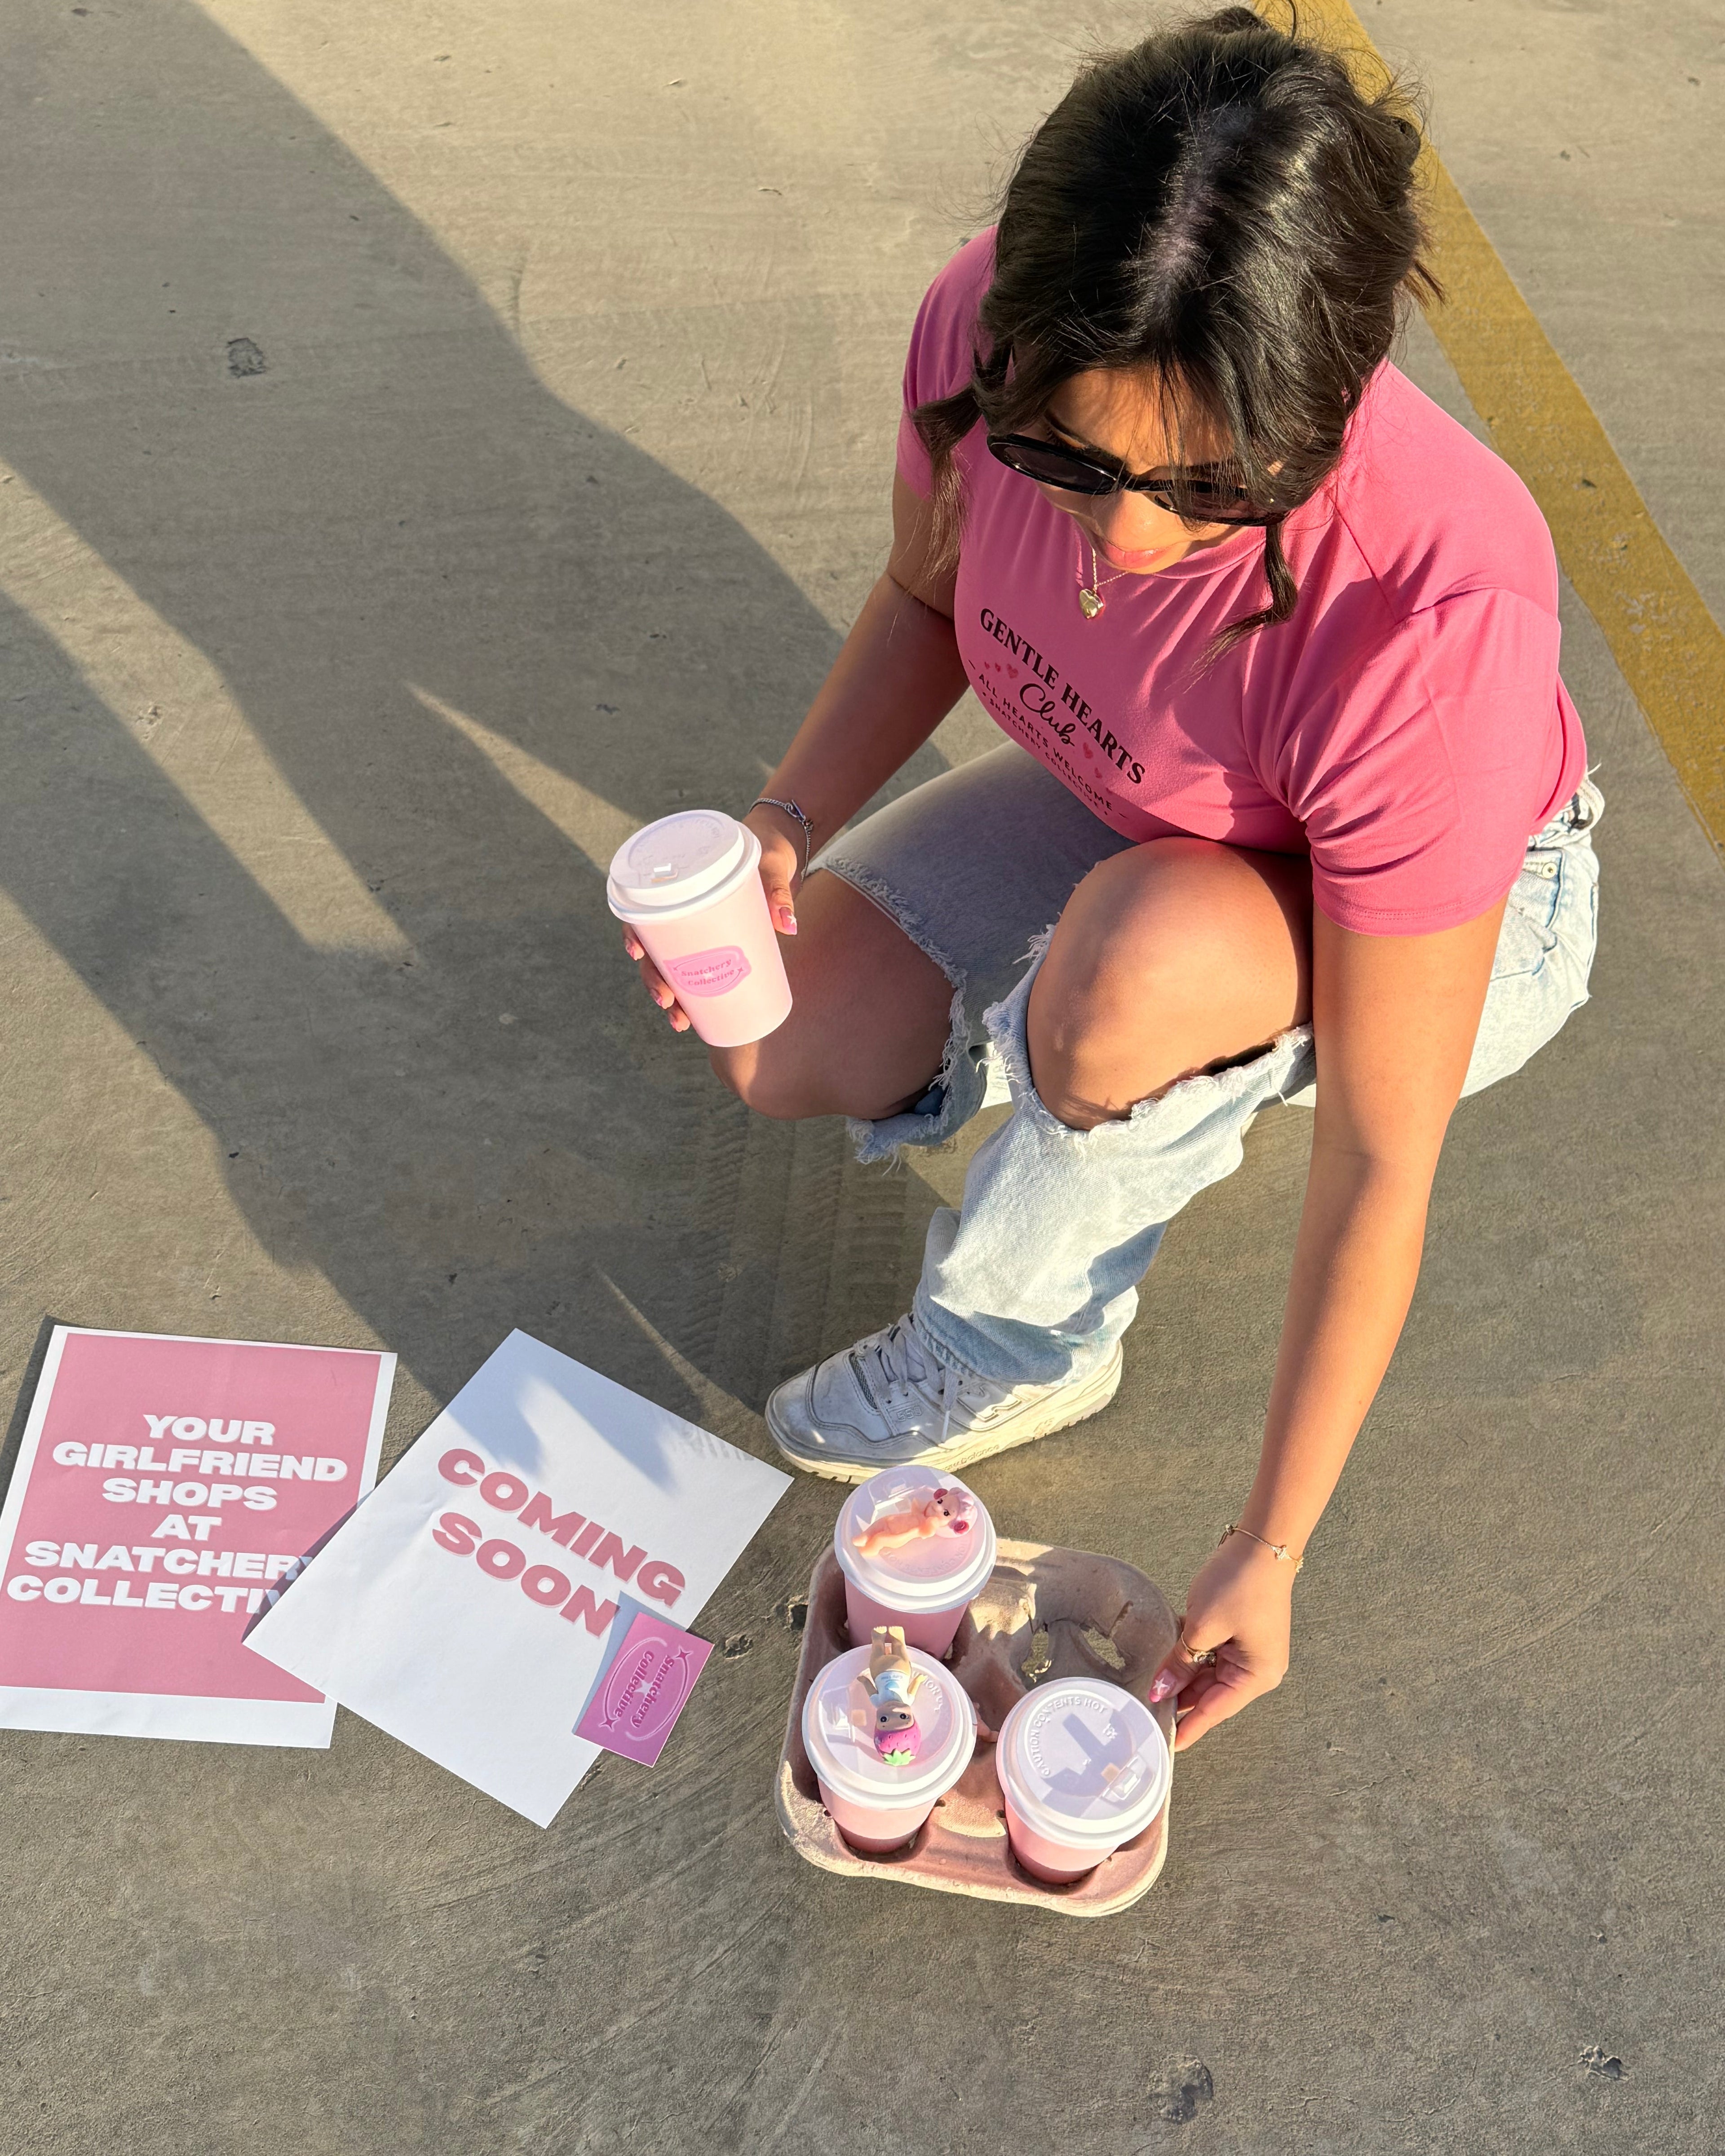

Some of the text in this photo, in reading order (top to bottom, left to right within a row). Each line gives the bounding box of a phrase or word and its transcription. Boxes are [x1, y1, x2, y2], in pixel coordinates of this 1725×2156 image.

[980, 608, 1146, 784] GENTLE HEARTS
[1019, 683, 1075, 747] Club
[979, 674, 1112, 811] ALL HEARTS WELCOME
[681, 958, 732, 976] Snatchery
[688, 969, 734, 986] Collective
[53, 1441, 348, 1482] GIRLFRIEND
[142, 1414, 276, 1446] YOUR
[102, 1477, 278, 1511] SHOPS
[150, 1514, 222, 1542] AT
[438, 1448, 686, 1609] COMING
[432, 1512, 621, 1639] SOON
[613, 1650, 655, 1718] Collective
[630, 1654, 675, 1728] Snatchery
